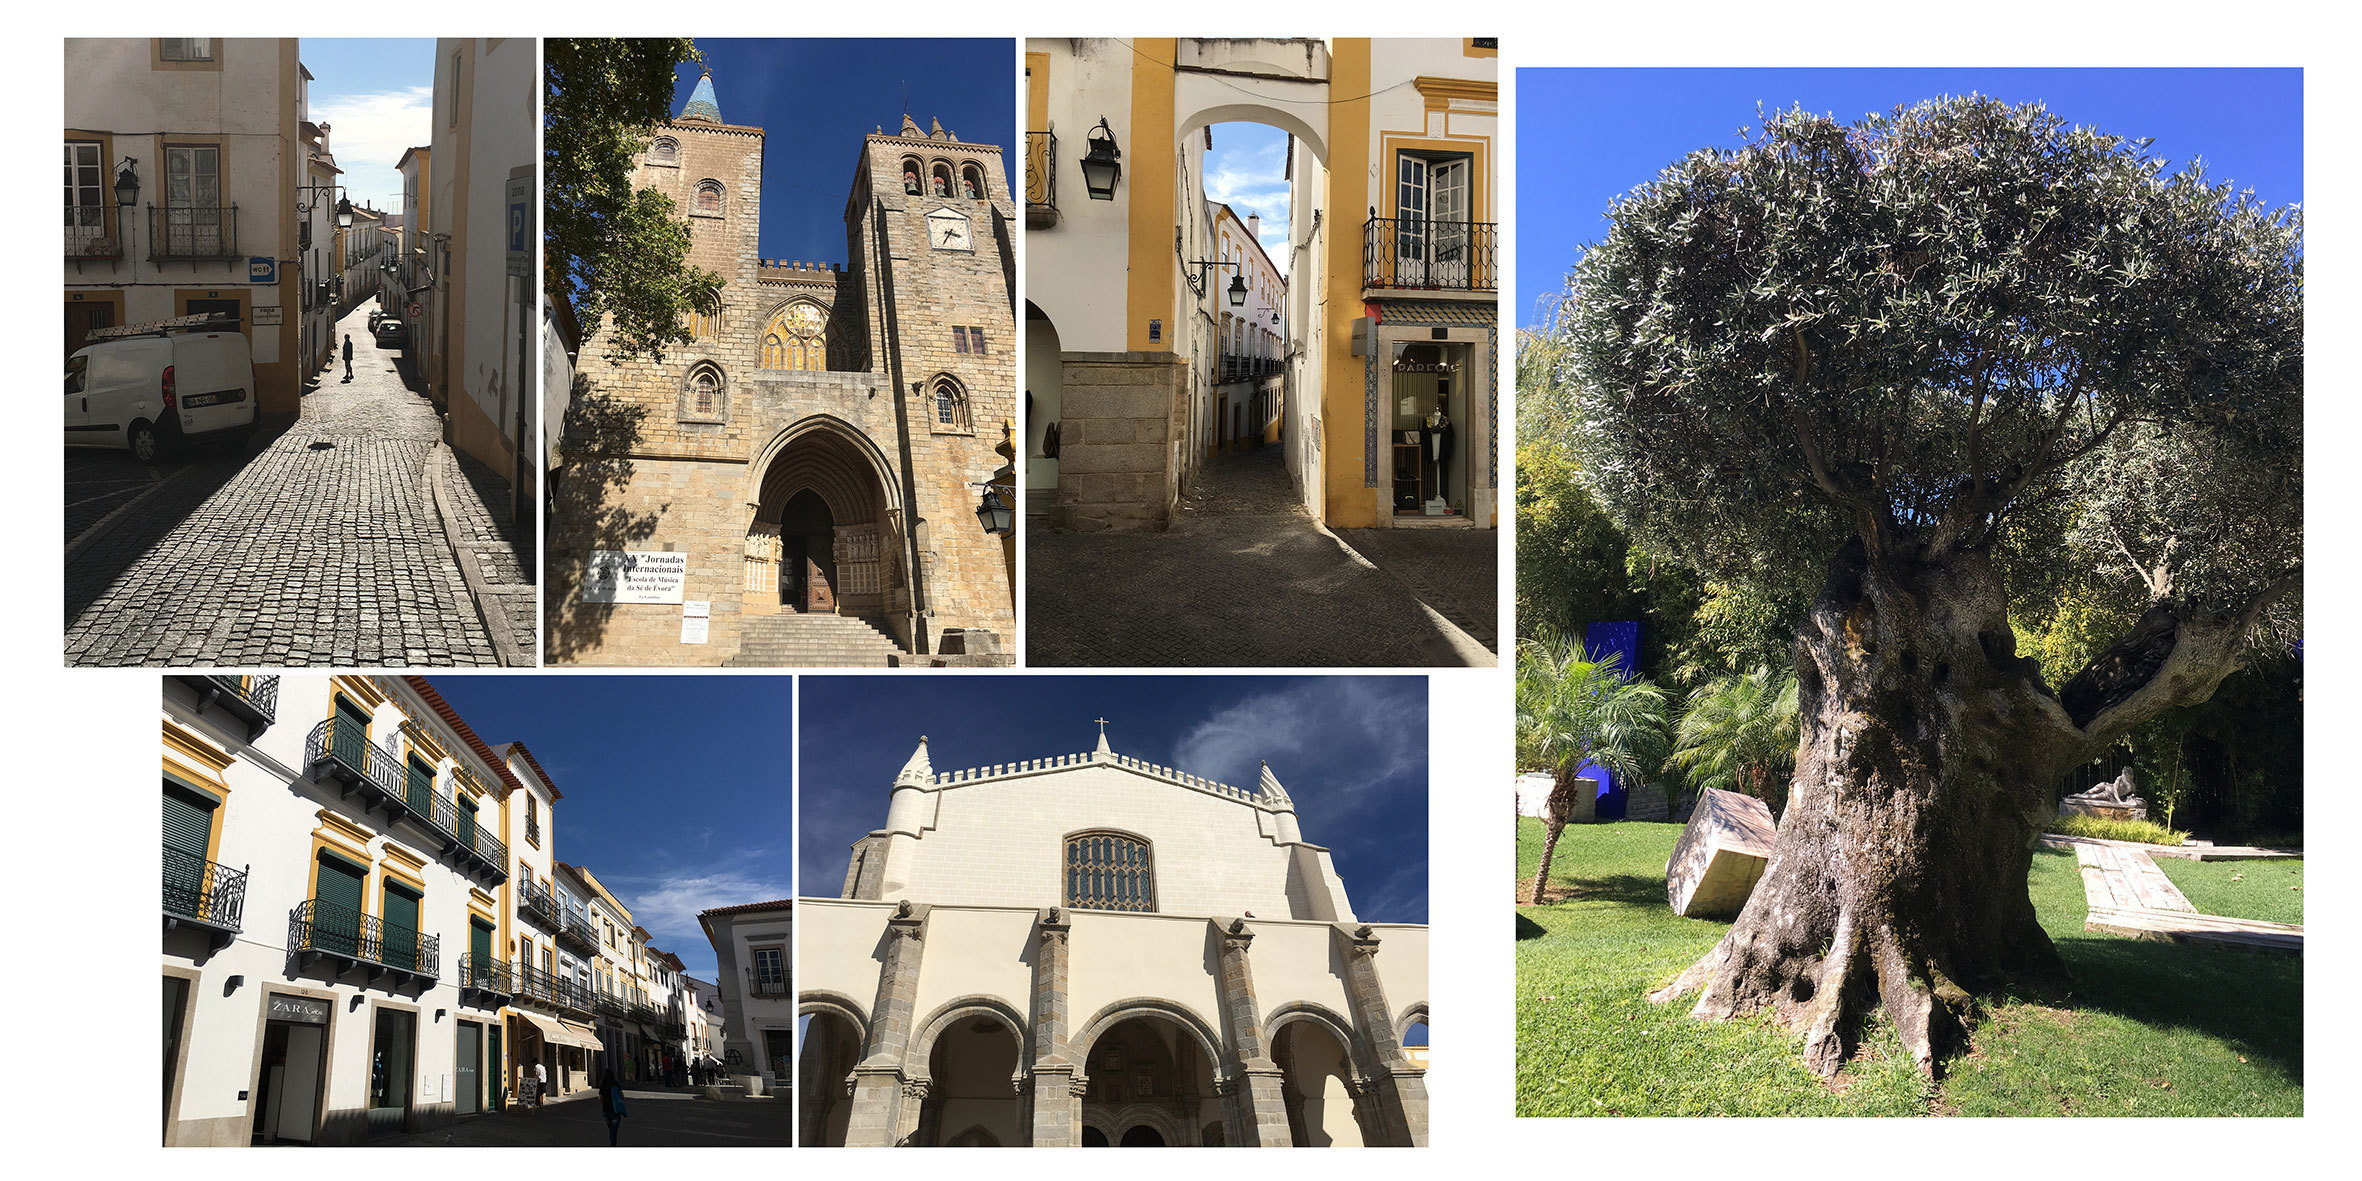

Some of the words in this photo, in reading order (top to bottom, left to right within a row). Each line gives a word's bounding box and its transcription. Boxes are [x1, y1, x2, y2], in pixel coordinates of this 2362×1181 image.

[512, 209, 521, 246] P
[623, 564, 683, 574] Internacionais
[273, 1001, 309, 1014] ZARA
